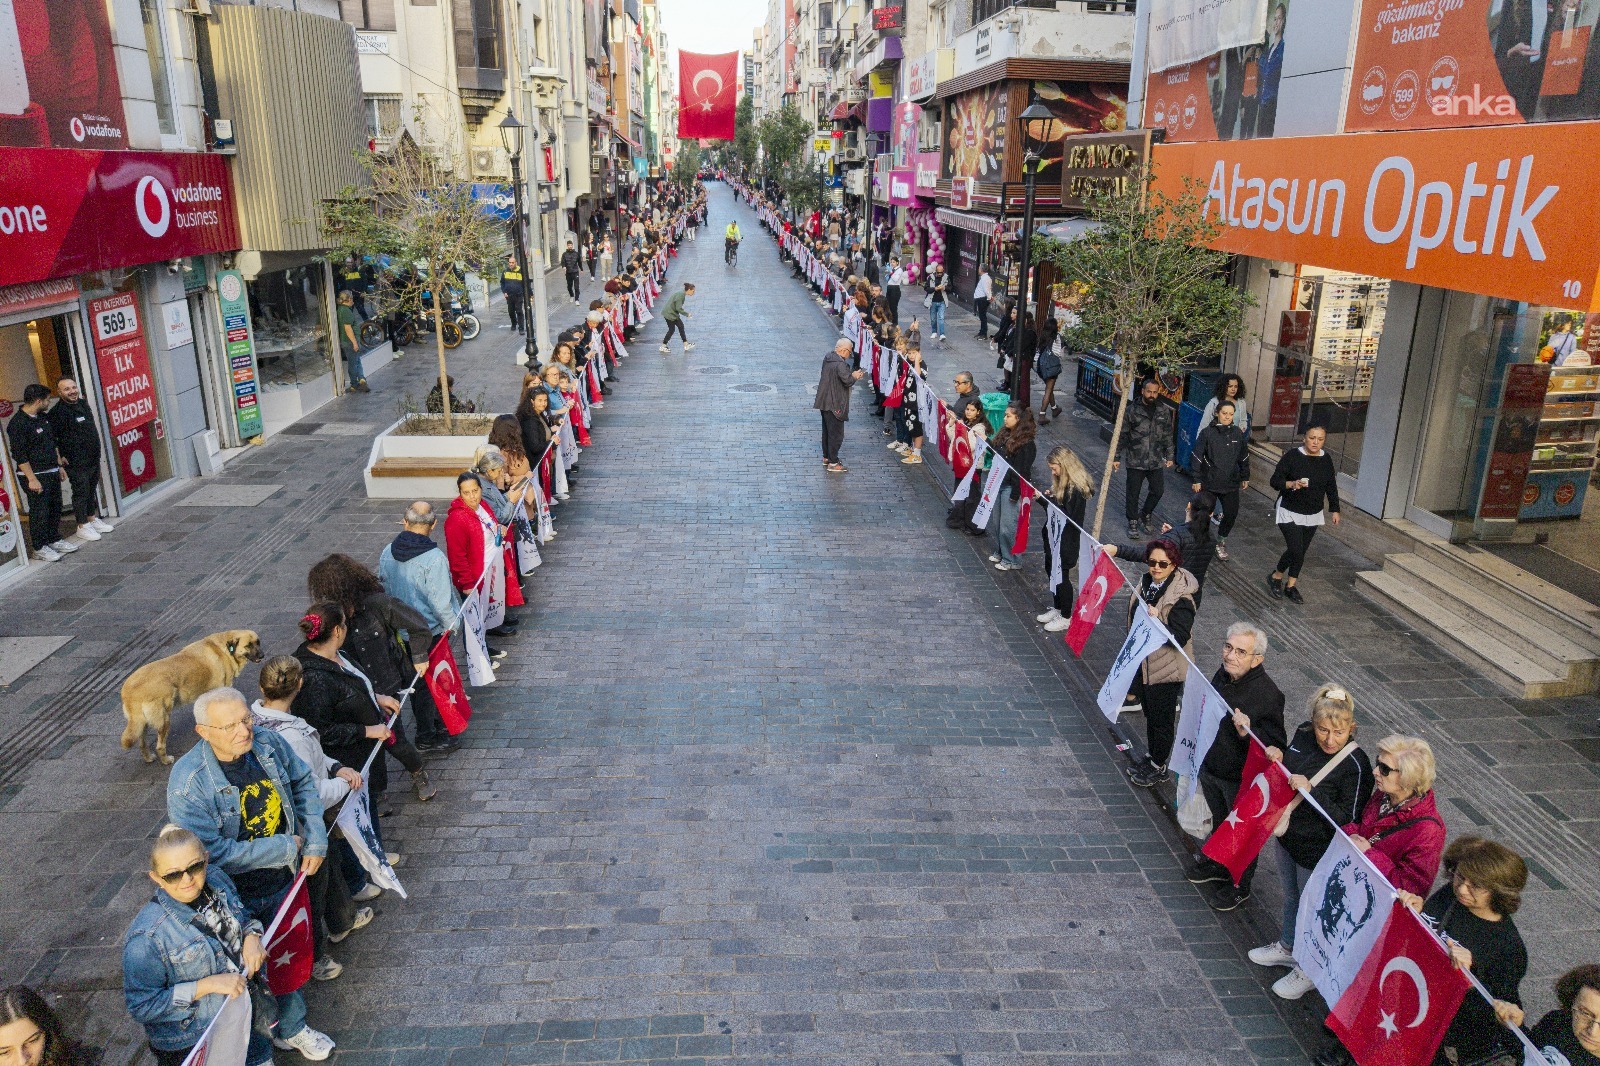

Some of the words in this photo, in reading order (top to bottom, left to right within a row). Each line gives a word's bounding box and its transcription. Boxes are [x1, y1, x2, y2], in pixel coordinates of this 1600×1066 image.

[1391, 22, 1441, 45] bakarız
[1395, 88, 1414, 103] 599
[85, 124, 122, 138] vodafone
[172, 183, 222, 203] vodafone
[176, 208, 219, 229] business
[1201, 159, 1346, 238] Atasun
[1364, 154, 1560, 270] Optik
[1562, 279, 1582, 299] 10
[93, 301, 102, 312] EV
[102, 311, 126, 335] 569
[127, 317, 136, 328] TL
[113, 353, 135, 374] İLK
[106, 373, 150, 403] FATURA
[111, 396, 153, 427] BİZDEN
